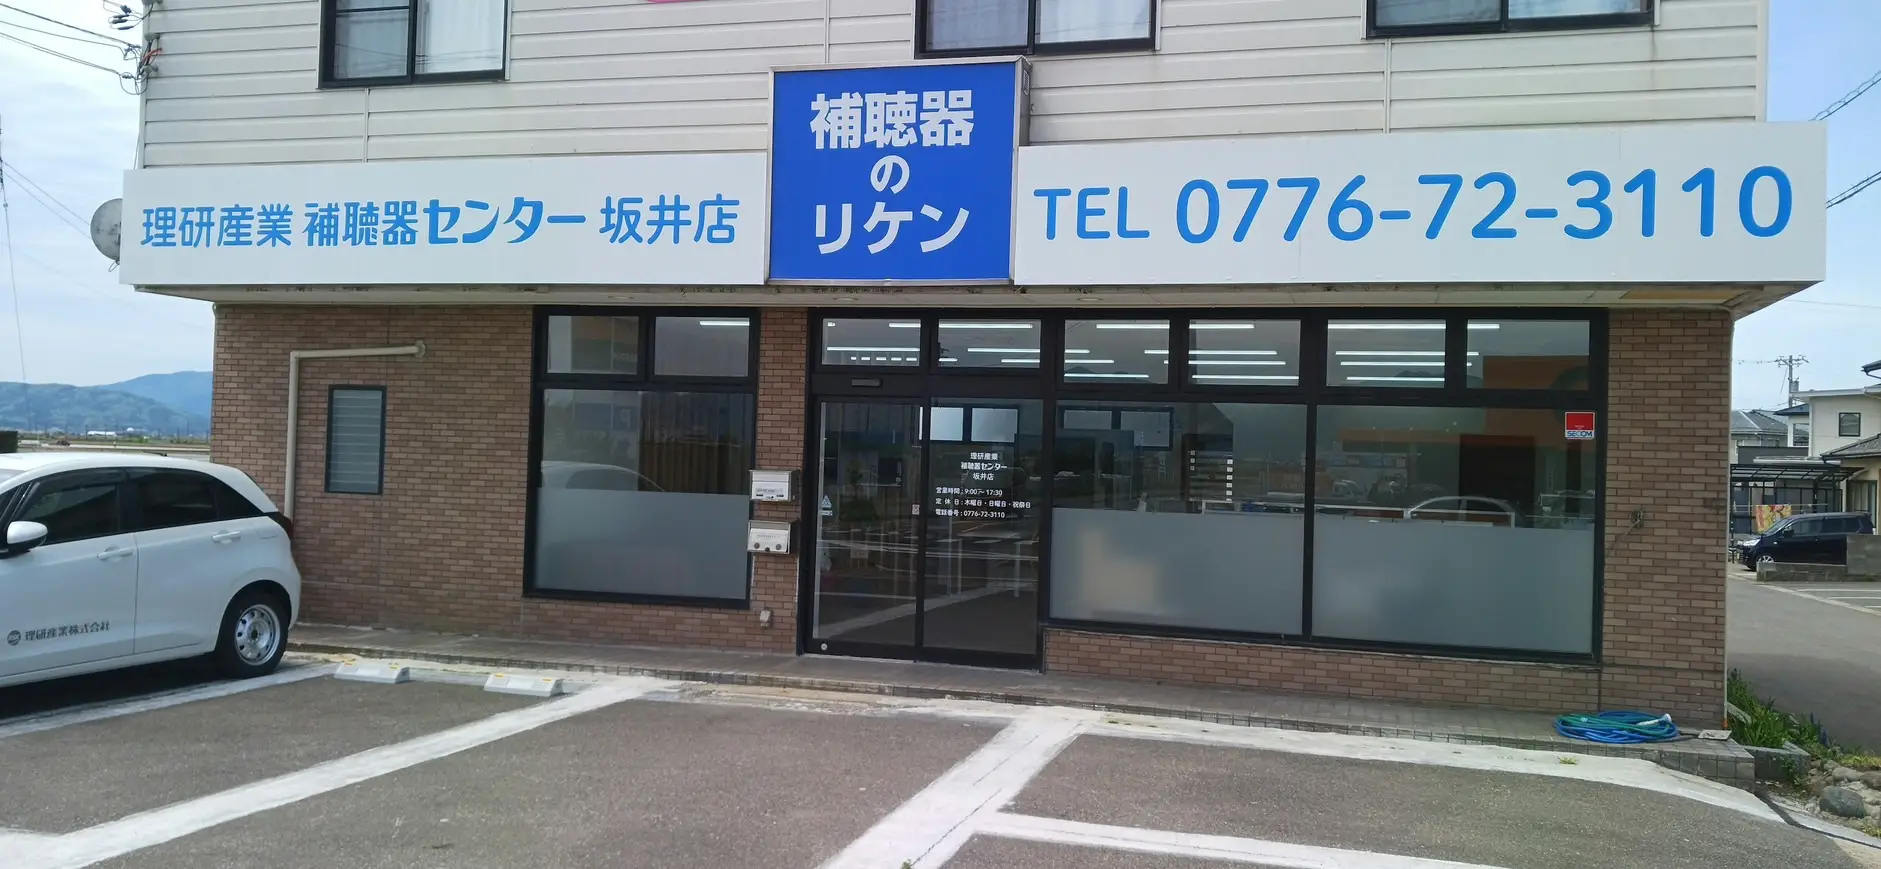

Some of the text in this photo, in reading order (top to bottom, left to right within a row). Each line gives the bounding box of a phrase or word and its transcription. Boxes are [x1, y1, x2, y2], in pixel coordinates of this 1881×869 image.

[810, 90, 974, 149] 補聴器
[870, 155, 910, 194] の
[140, 193, 741, 249] 理研産業 補聴器センター 坂井店
[1033, 165, 1793, 245] TEL 0776-72-3110
[815, 202, 970, 254] リケン
[960, 461, 1008, 471] 補聴器センター
[970, 451, 999, 461] 理研産業
[972, 472, 995, 481] 坂井店
[24, 620, 110, 641] 理研産業株式会社
